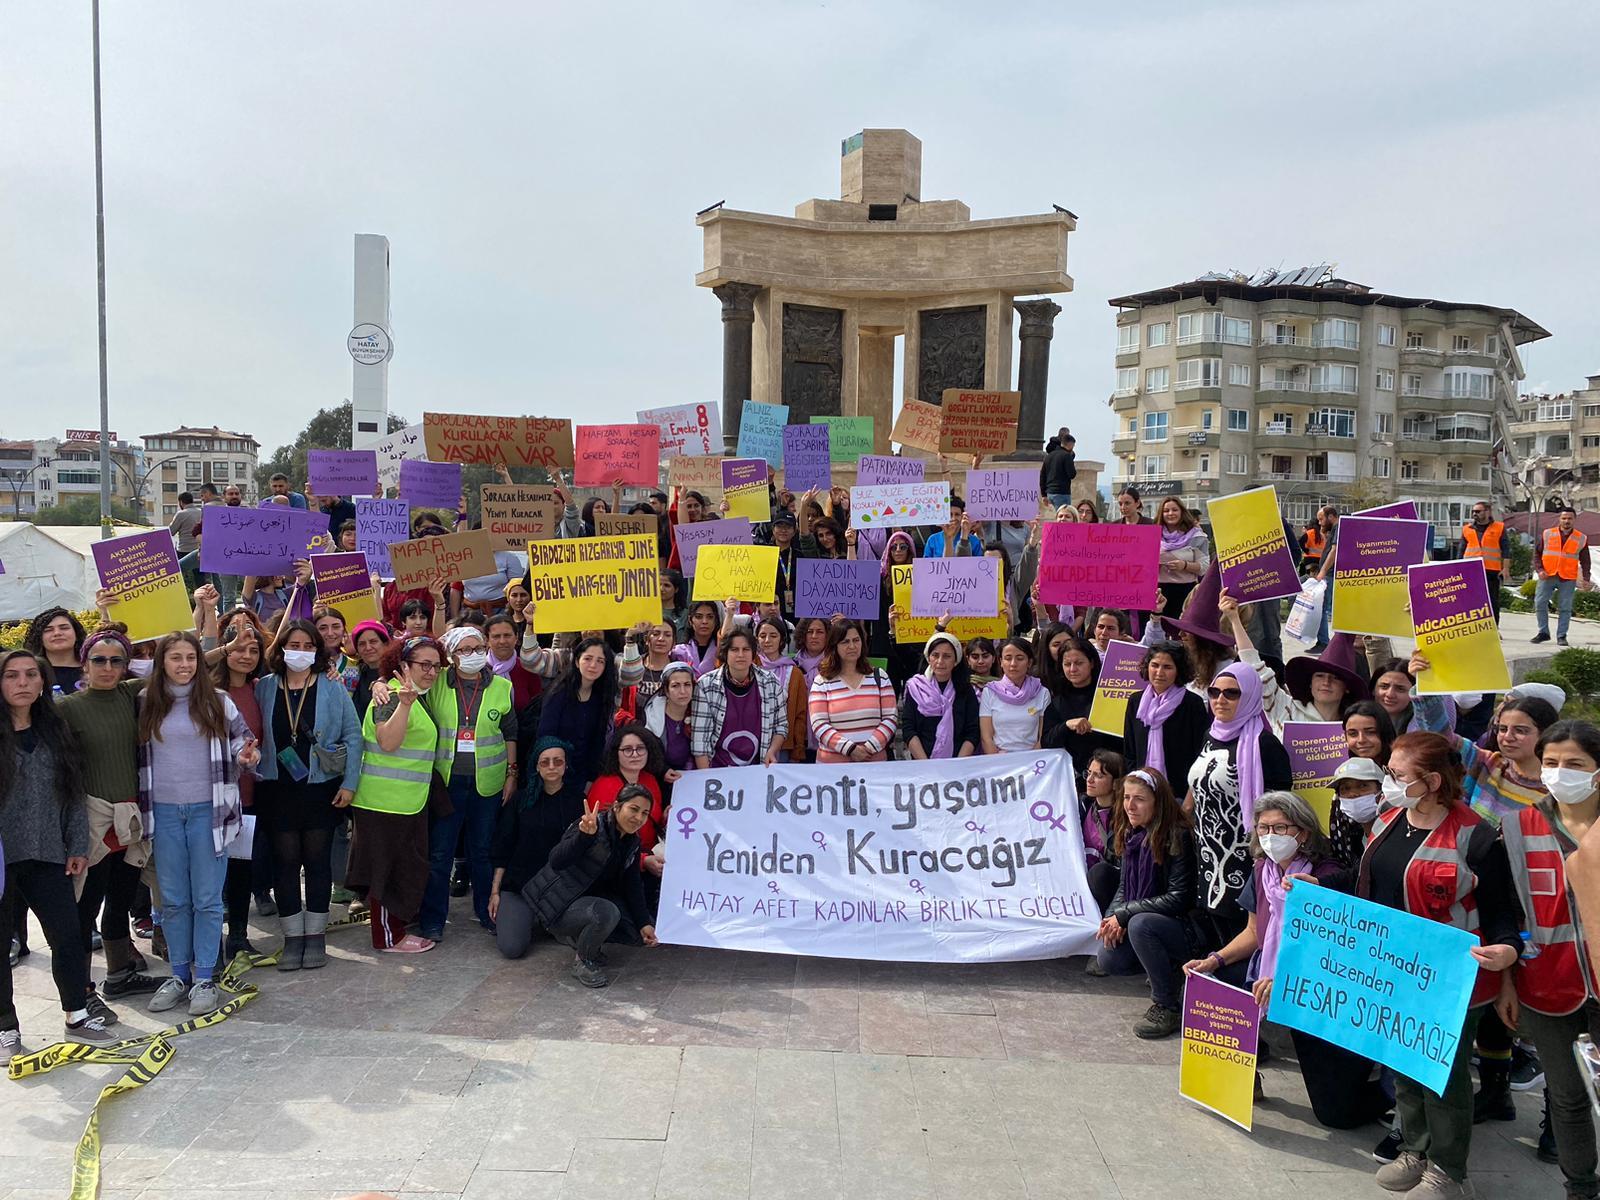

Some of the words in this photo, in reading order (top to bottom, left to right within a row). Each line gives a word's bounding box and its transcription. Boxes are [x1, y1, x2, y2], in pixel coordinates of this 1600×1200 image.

[423, 413, 492, 427] SORULACAK
[526, 419, 566, 432] HESAP
[696, 404, 708, 427] 8
[443, 429, 515, 442] KURULACAK
[516, 446, 560, 466] VAR
[970, 488, 1038, 504] BERXWEDANA
[981, 508, 1019, 518] JINAN
[358, 519, 407, 534] YASTAYIZ
[600, 522, 612, 535] BU
[110, 541, 147, 559] AKP-MHP
[394, 538, 445, 558] MARA
[436, 548, 472, 564] HAYA
[1221, 539, 1286, 573] MÜCADELEYİ
[1360, 547, 1396, 556] öfkemizle
[118, 550, 147, 564] faşizmi
[106, 569, 140, 584] sosyalist
[139, 557, 172, 572] feminist
[730, 566, 756, 576] HAYA
[812, 564, 857, 579] KADIN
[1336, 566, 1402, 578] BURADAYIZ
[1424, 573, 1463, 589] Patriyarkal
[319, 589, 340, 599] HESAP
[1425, 583, 1467, 599] kapitalizme
[1439, 594, 1457, 604] karşı
[1415, 603, 1490, 634] MÜCADELEYİ
[1100, 678, 1136, 688] HESAP
[1102, 690, 1130, 699] VERE
[1292, 737, 1328, 748] Deprem
[1330, 733, 1345, 743] değ
[1296, 746, 1320, 755] rantçı
[1322, 742, 1348, 752] düzen
[1306, 751, 1343, 761] öldürdü.
[1291, 771, 1316, 780] ESAP
[703, 779, 744, 811] Bu
[766, 775, 882, 818] kenti,
[892, 775, 1026, 830] yaşamı
[703, 833, 814, 876] Yeniden
[847, 829, 1050, 888] Kuracağız
[682, 890, 744, 914] HATAY
[752, 898, 799, 918] AFET
[814, 898, 909, 922] KADINLAR
[920, 897, 1008, 922] BİRLİKTE
[1020, 890, 1085, 920] GÜÇLÜ
[1291, 917, 1356, 950] güvende
[1369, 940, 1437, 991] olmadığı
[1320, 949, 1395, 997] düzenden
[1195, 1000, 1214, 1010] Erkek
[1190, 1009, 1208, 1018] rantçı
[1210, 1011, 1234, 1022] düzene
[1234, 1017, 1252, 1028] karşı
[1209, 1021, 1232, 1031] yaşamı
[1282, 974, 1348, 1020] HESAP
[1351, 997, 1457, 1067] SORACAĞIZ
[1184, 1027, 1240, 1048] BERABER
[1189, 1043, 1254, 1067] KURACAĞIZ!
